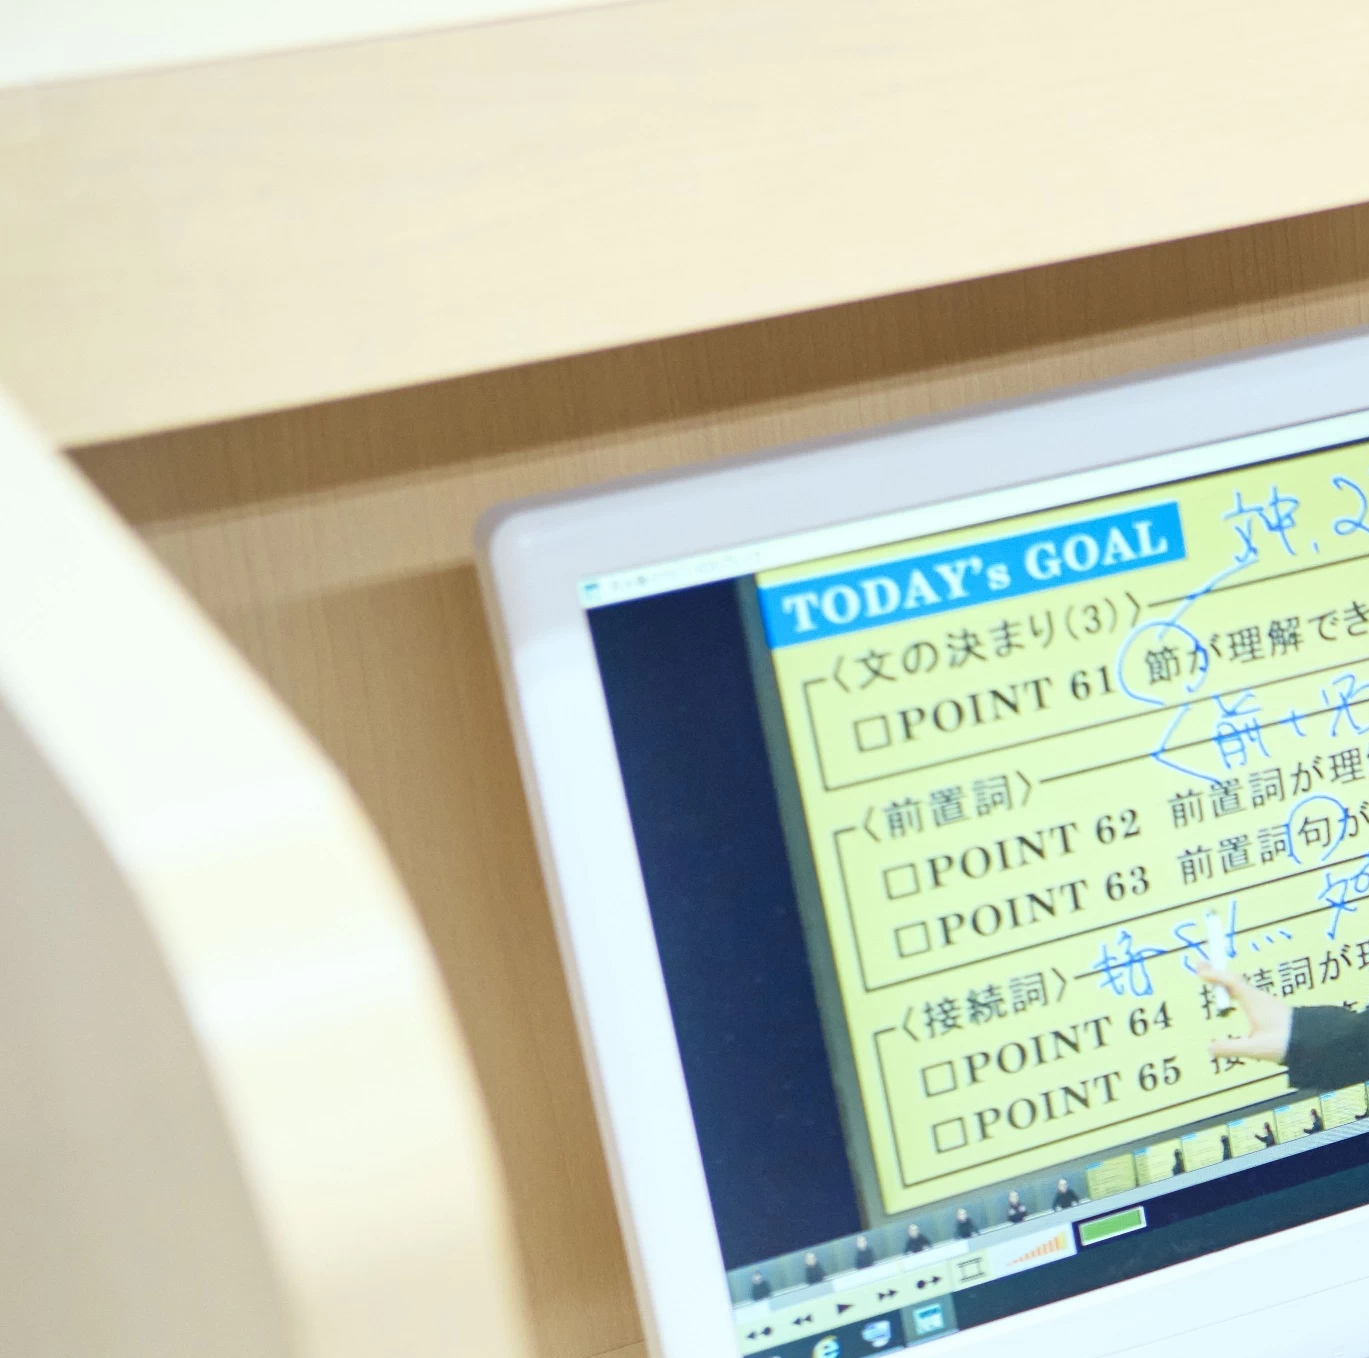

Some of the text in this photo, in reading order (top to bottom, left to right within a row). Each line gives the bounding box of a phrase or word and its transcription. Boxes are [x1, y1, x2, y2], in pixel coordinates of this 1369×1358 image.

[781, 555, 1012, 634] TODAY's
[1024, 519, 1169, 582] GOAL
[901, 676, 1054, 739] POINT
[1069, 663, 1116, 700] 61
[928, 822, 1078, 890] POINT
[1095, 809, 1141, 843] 62
[939, 880, 1087, 946] POINT
[1105, 866, 1150, 902] 63
[967, 1016, 1111, 1082] POINT
[1129, 1001, 1174, 1036] 64
[974, 1056, 1182, 1141] POINT 65
